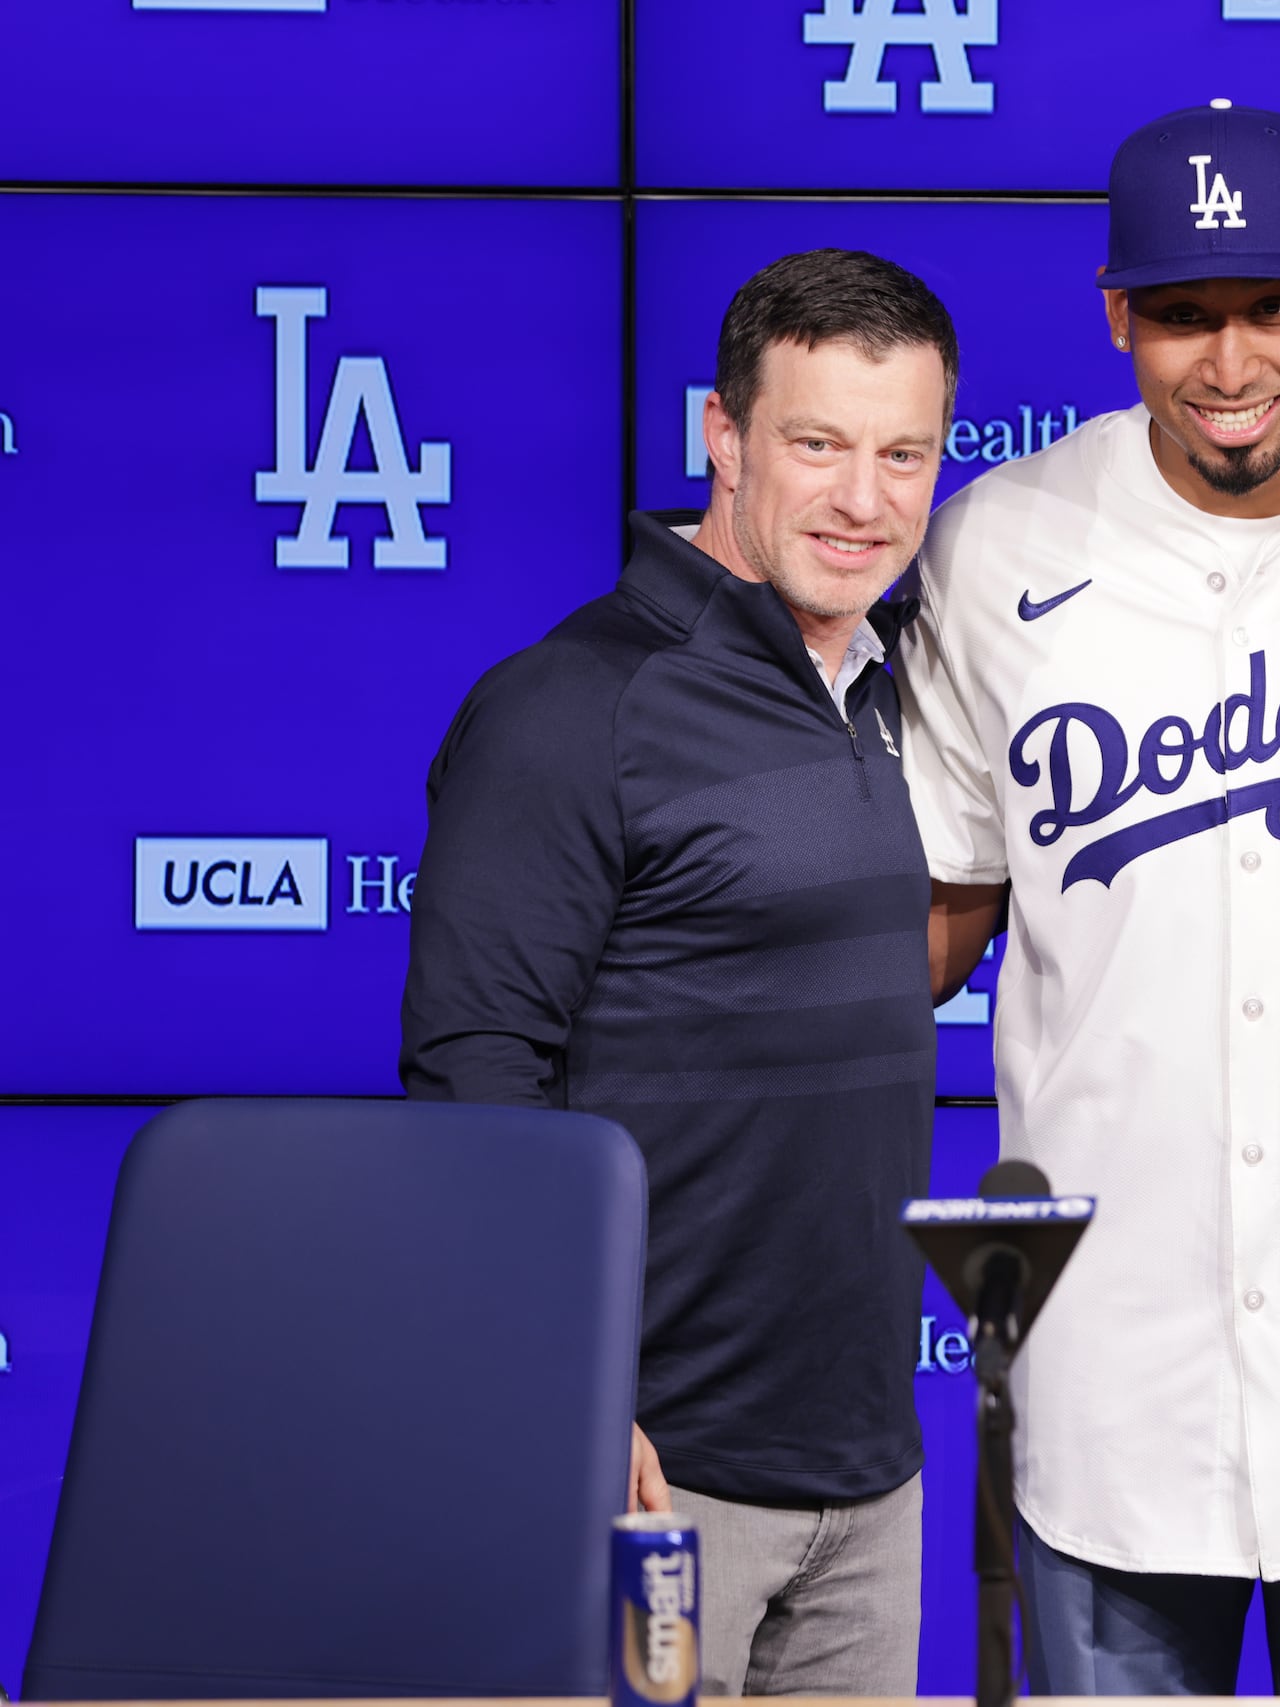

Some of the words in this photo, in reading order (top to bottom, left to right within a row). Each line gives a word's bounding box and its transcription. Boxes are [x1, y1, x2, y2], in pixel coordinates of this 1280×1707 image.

[1188, 154, 1247, 229] LA
[255, 287, 451, 569] LA
[941, 404, 1085, 463] ealt
[163, 860, 303, 906] UCLA
[642, 1551, 683, 1685] smart
